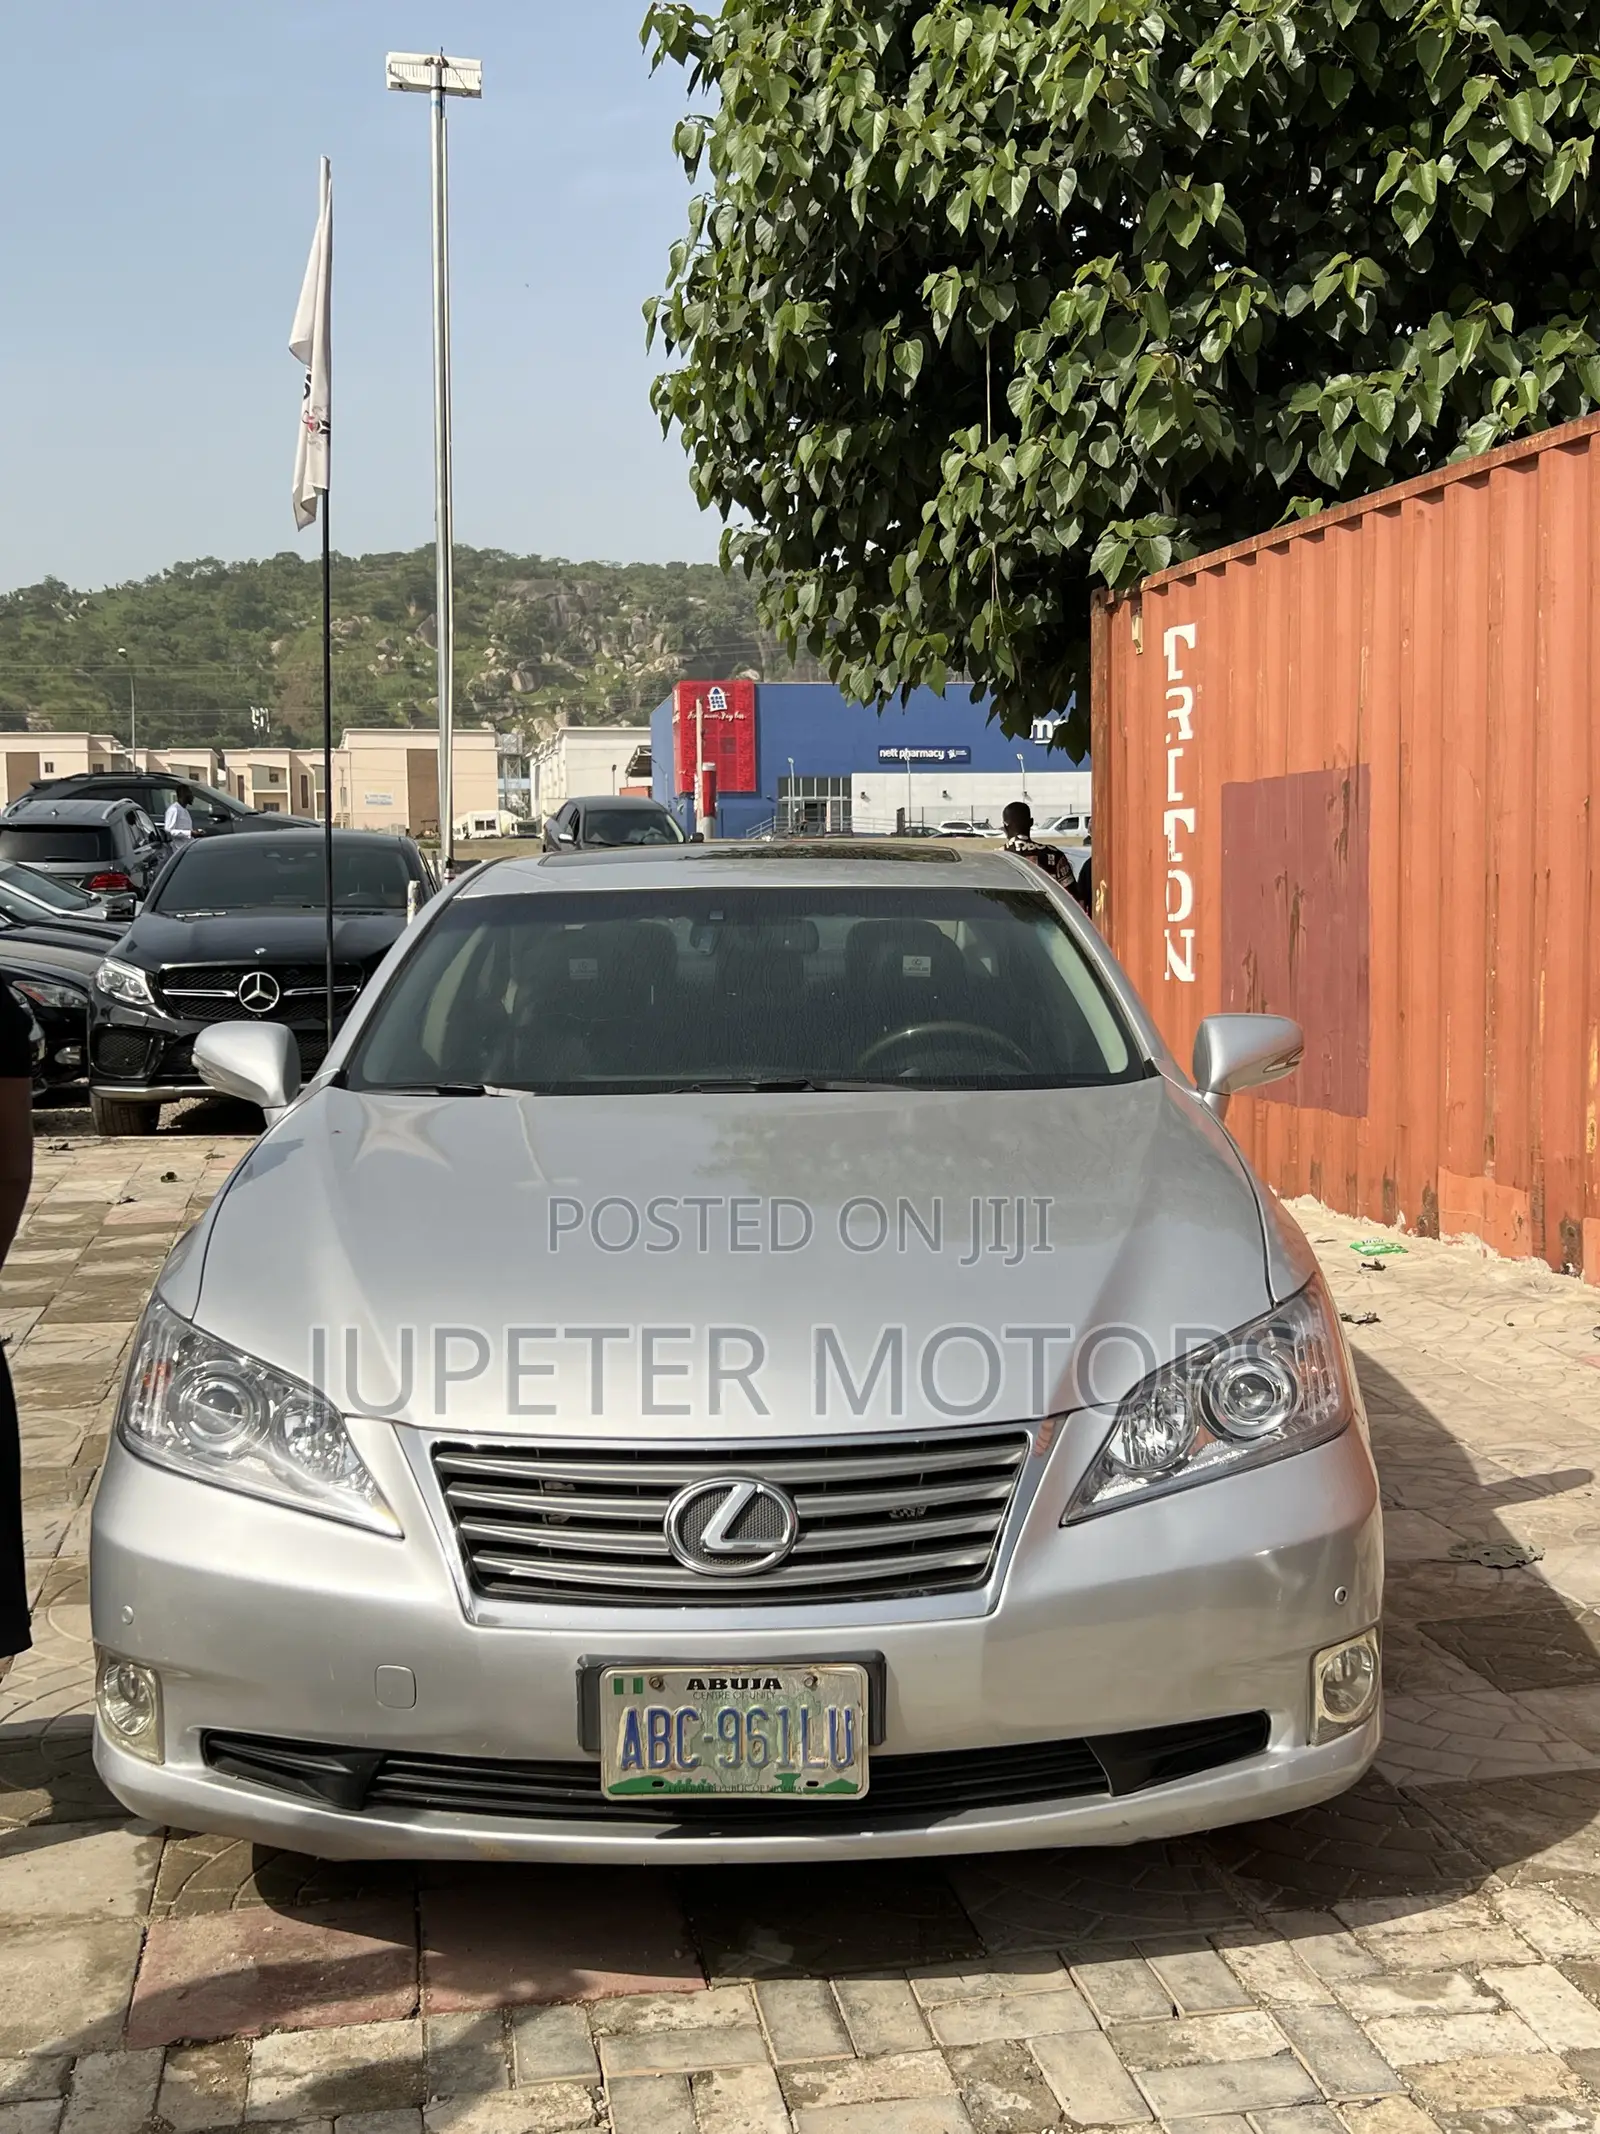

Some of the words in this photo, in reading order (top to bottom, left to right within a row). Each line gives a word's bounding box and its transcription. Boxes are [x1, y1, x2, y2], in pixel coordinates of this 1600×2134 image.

[899, 748, 945, 760] pharmacy
[686, 1677, 782, 1690] ABUJA
[693, 1691, 730, 1700] CENTRE
[733, 1691, 747, 1700] OF
[749, 1691, 776, 1700] UNITY
[619, 1706, 855, 1770] ABC-961LU
